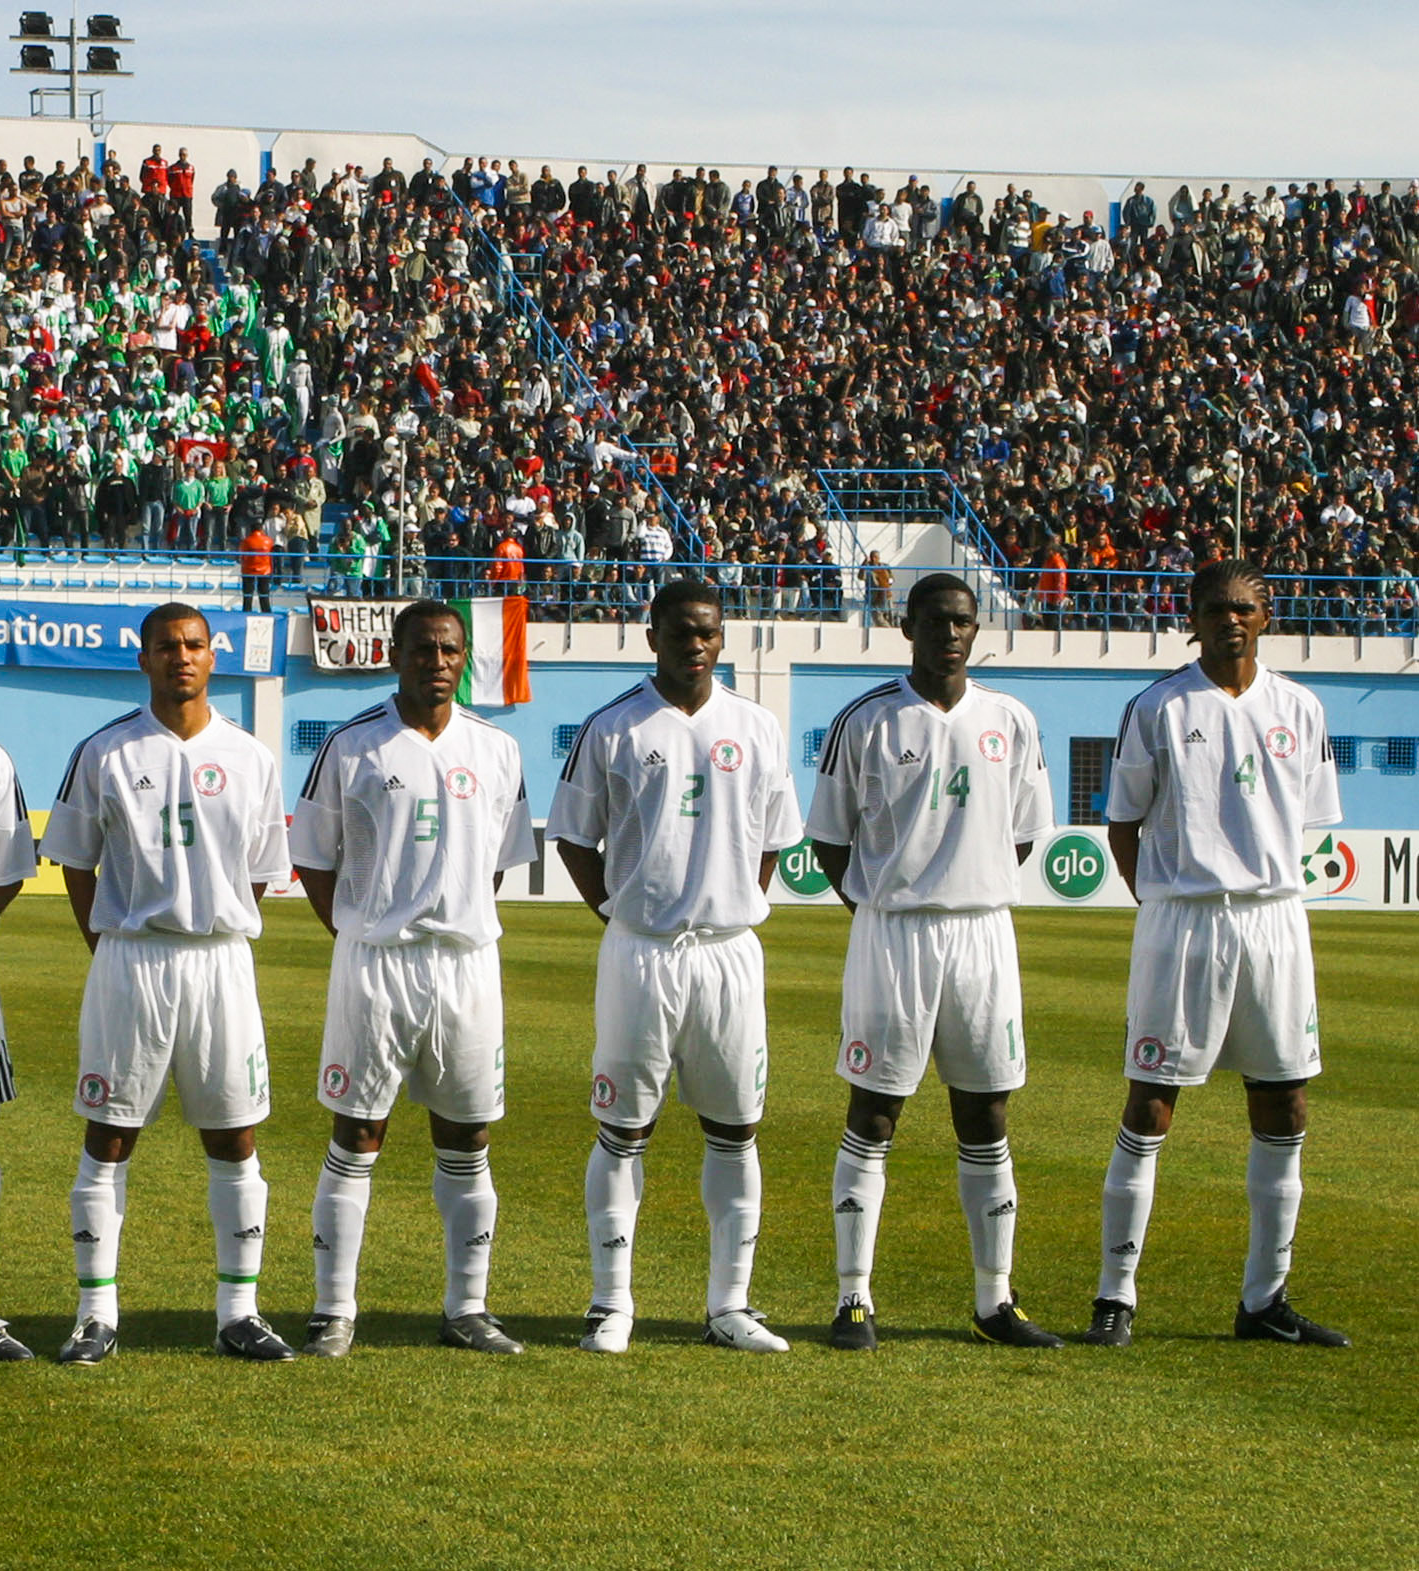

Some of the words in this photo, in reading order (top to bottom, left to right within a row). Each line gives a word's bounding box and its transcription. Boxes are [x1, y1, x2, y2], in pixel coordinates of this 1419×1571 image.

[679, 774, 705, 818] 2
[930, 766, 970, 810] 14
[1234, 754, 1257, 795] 4
[159, 801, 195, 849] 15
[414, 798, 439, 842] 5
[1052, 848, 1098, 885] glo
